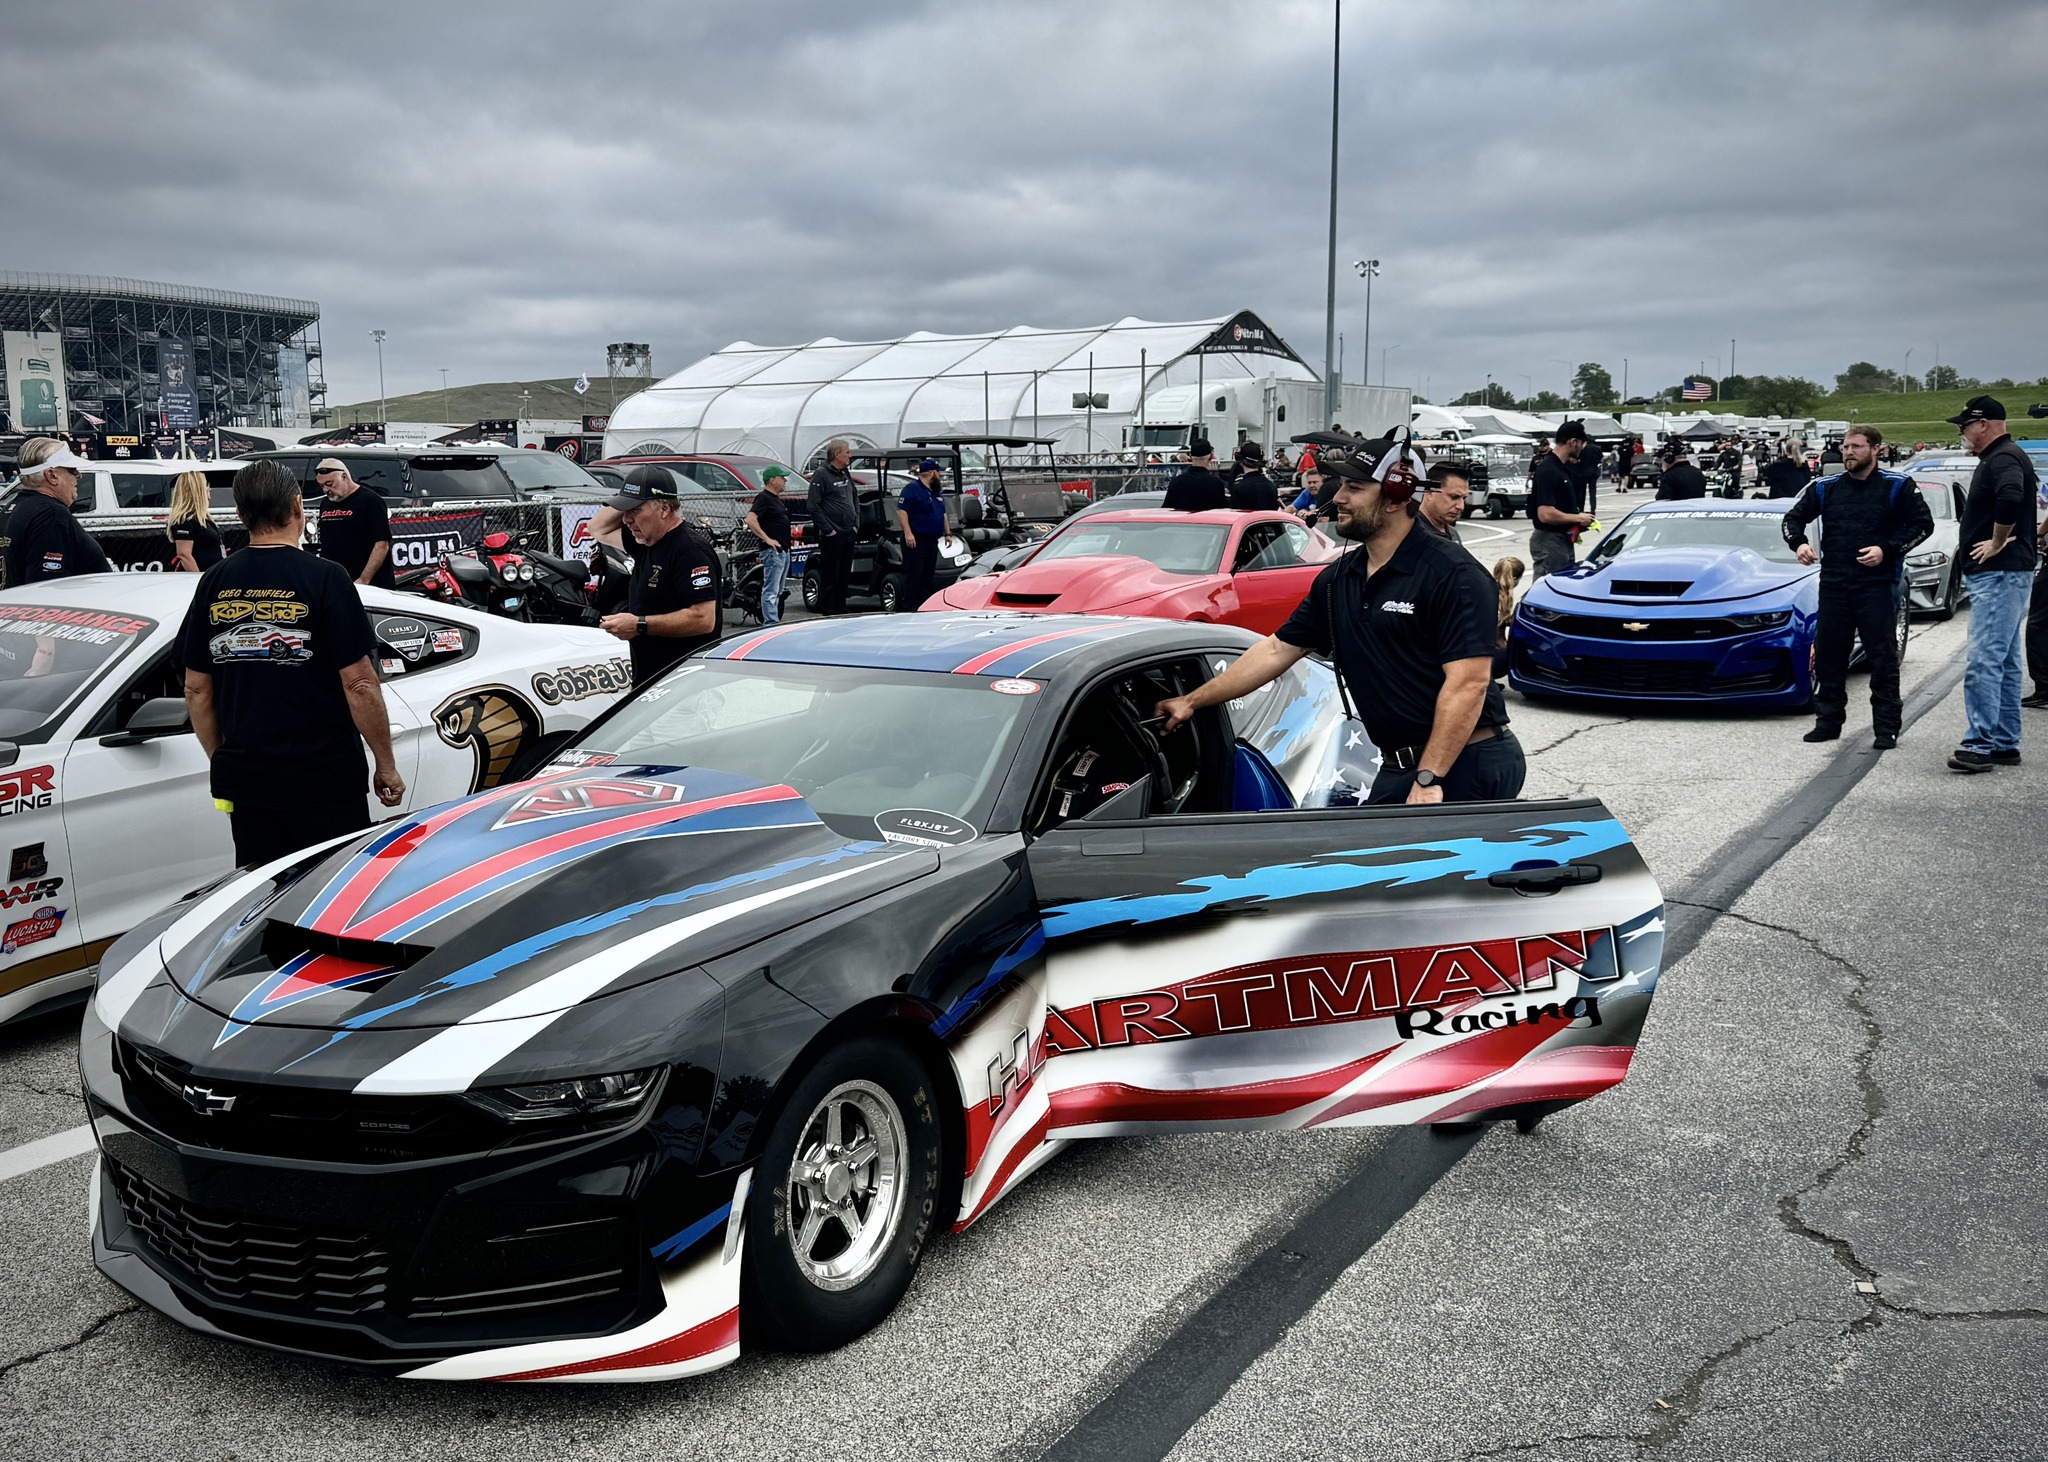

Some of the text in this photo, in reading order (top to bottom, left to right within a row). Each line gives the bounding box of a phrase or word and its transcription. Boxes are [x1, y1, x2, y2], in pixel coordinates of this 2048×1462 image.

[1708, 511, 1745, 519] NMCA
[1746, 512, 1785, 520] RACIN
[218, 589, 295, 599] GREG STANFIELD
[0, 606, 150, 635] RFORMANCE
[46, 625, 120, 645] RACING
[554, 750, 589, 766] Holley
[888, 833, 920, 843] FACTORY
[35, 907, 55, 919] NHRA
[7, 918, 56, 941] LUCAS OIL
[985, 925, 1620, 1117] HARTMAN
[1394, 996, 1603, 1040] Racing
